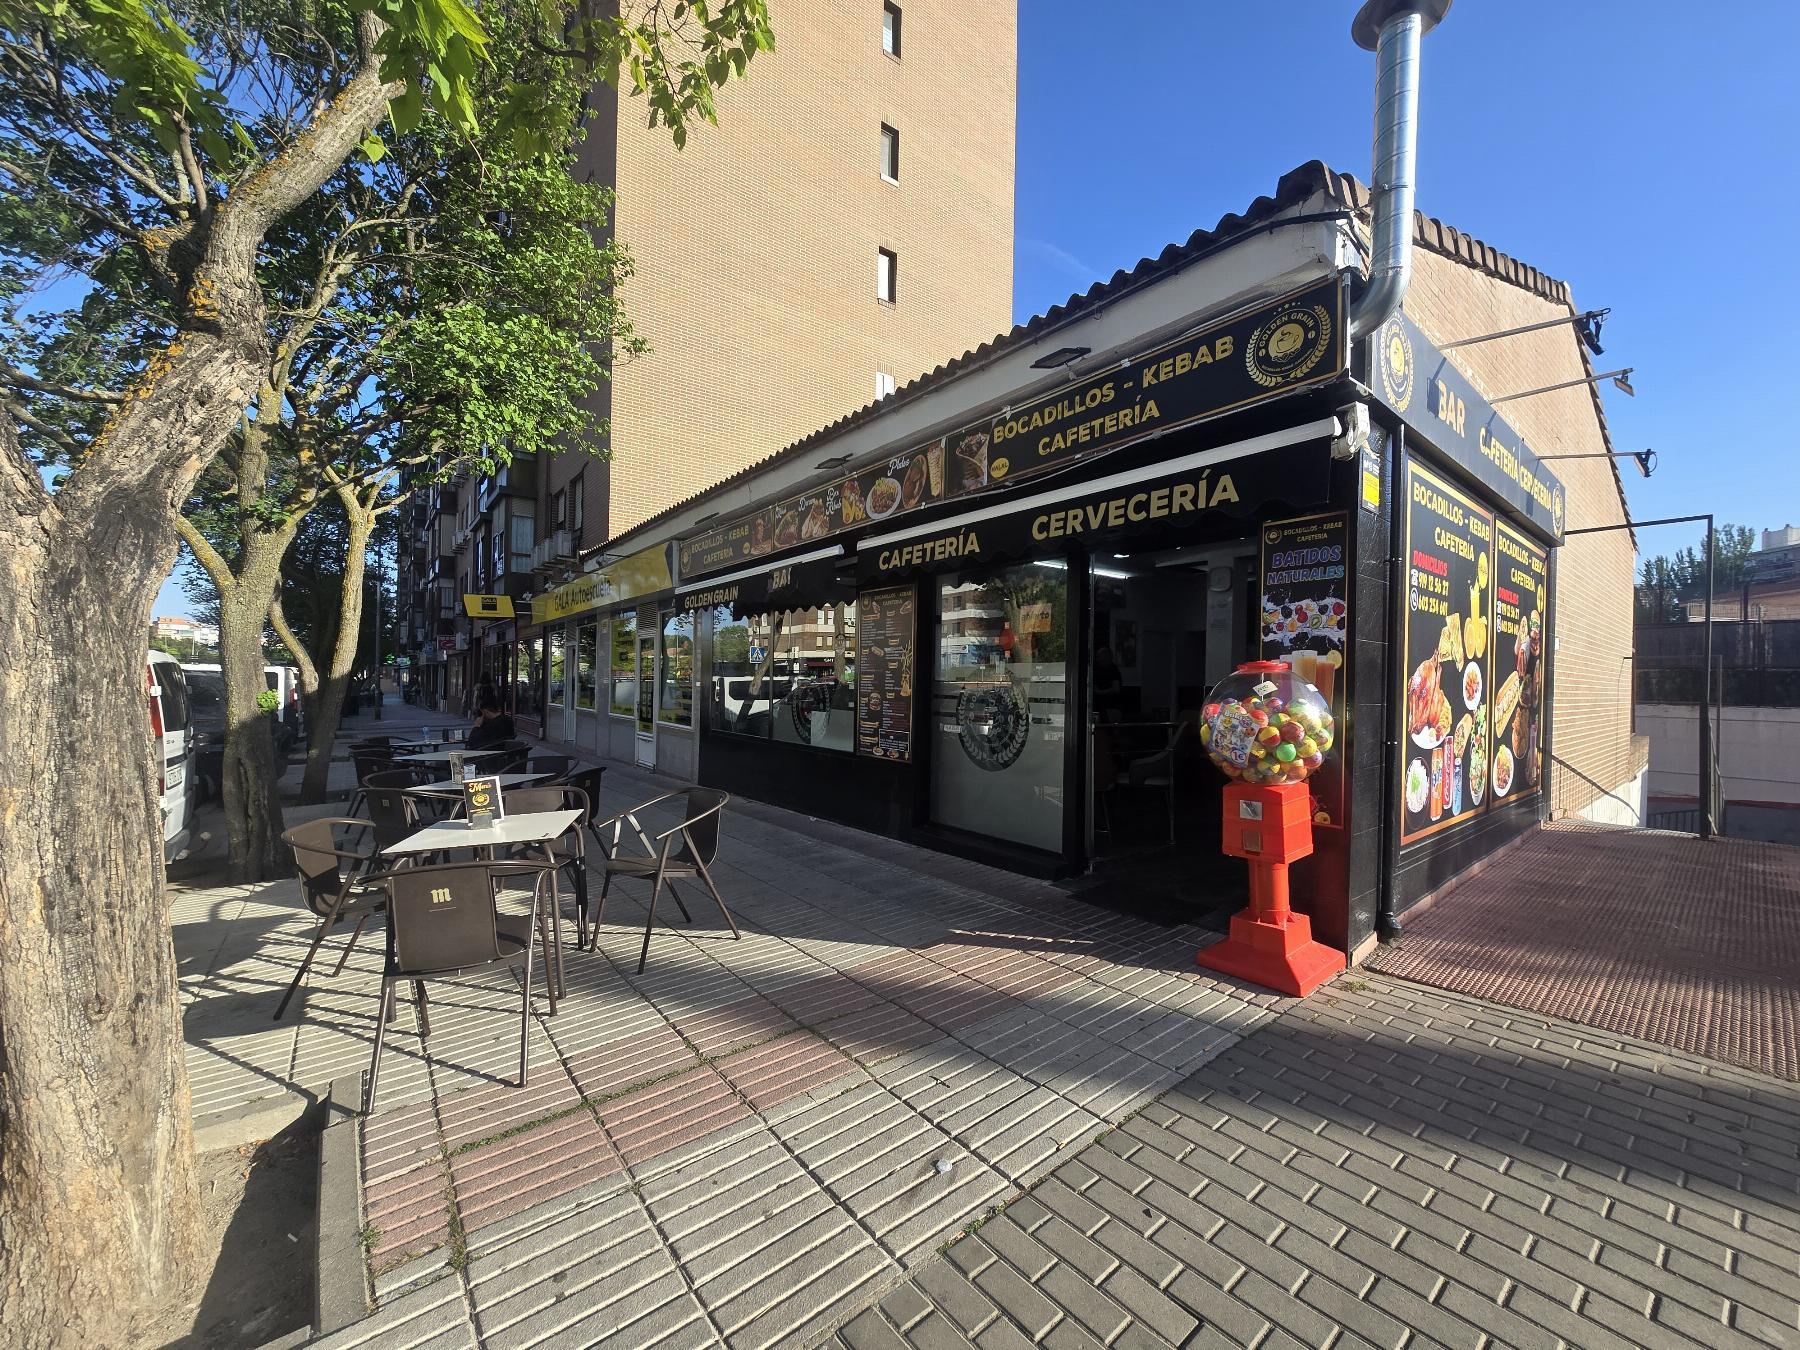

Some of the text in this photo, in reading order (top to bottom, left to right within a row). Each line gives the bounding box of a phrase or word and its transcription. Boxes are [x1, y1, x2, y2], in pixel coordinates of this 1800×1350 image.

[1260, 312, 1315, 347] GOLDEN GRAIN
[993, 382, 1115, 444] BOCADILLOS
[1142, 335, 1234, 388] KEBAB
[1038, 394, 1161, 456] CAFETERÍA
[1438, 380, 1466, 438] BAR
[1479, 426, 1519, 483] CAFETERÍA
[1031, 468, 1240, 541] CERVECERÍA
[1413, 482, 1463, 526] BOCADILLOS
[1469, 516, 1490, 542] KEBAB
[691, 535, 724, 554] BOCADILLOS
[729, 525, 749, 540] KEBAB
[1284, 525, 1318, 536] BOCADILLOS
[1435, 527, 1475, 562] CAFETERÍA
[879, 527, 980, 571] CAFETERÍA
[1272, 545, 1341, 569] BATIDOS
[1498, 534, 1529, 566] BOCADILLOS
[1267, 565, 1345, 585] NATURALES
[554, 577, 612, 612] GALA Autoescuela
[685, 586, 739, 609] GOLDEN GRAIN
